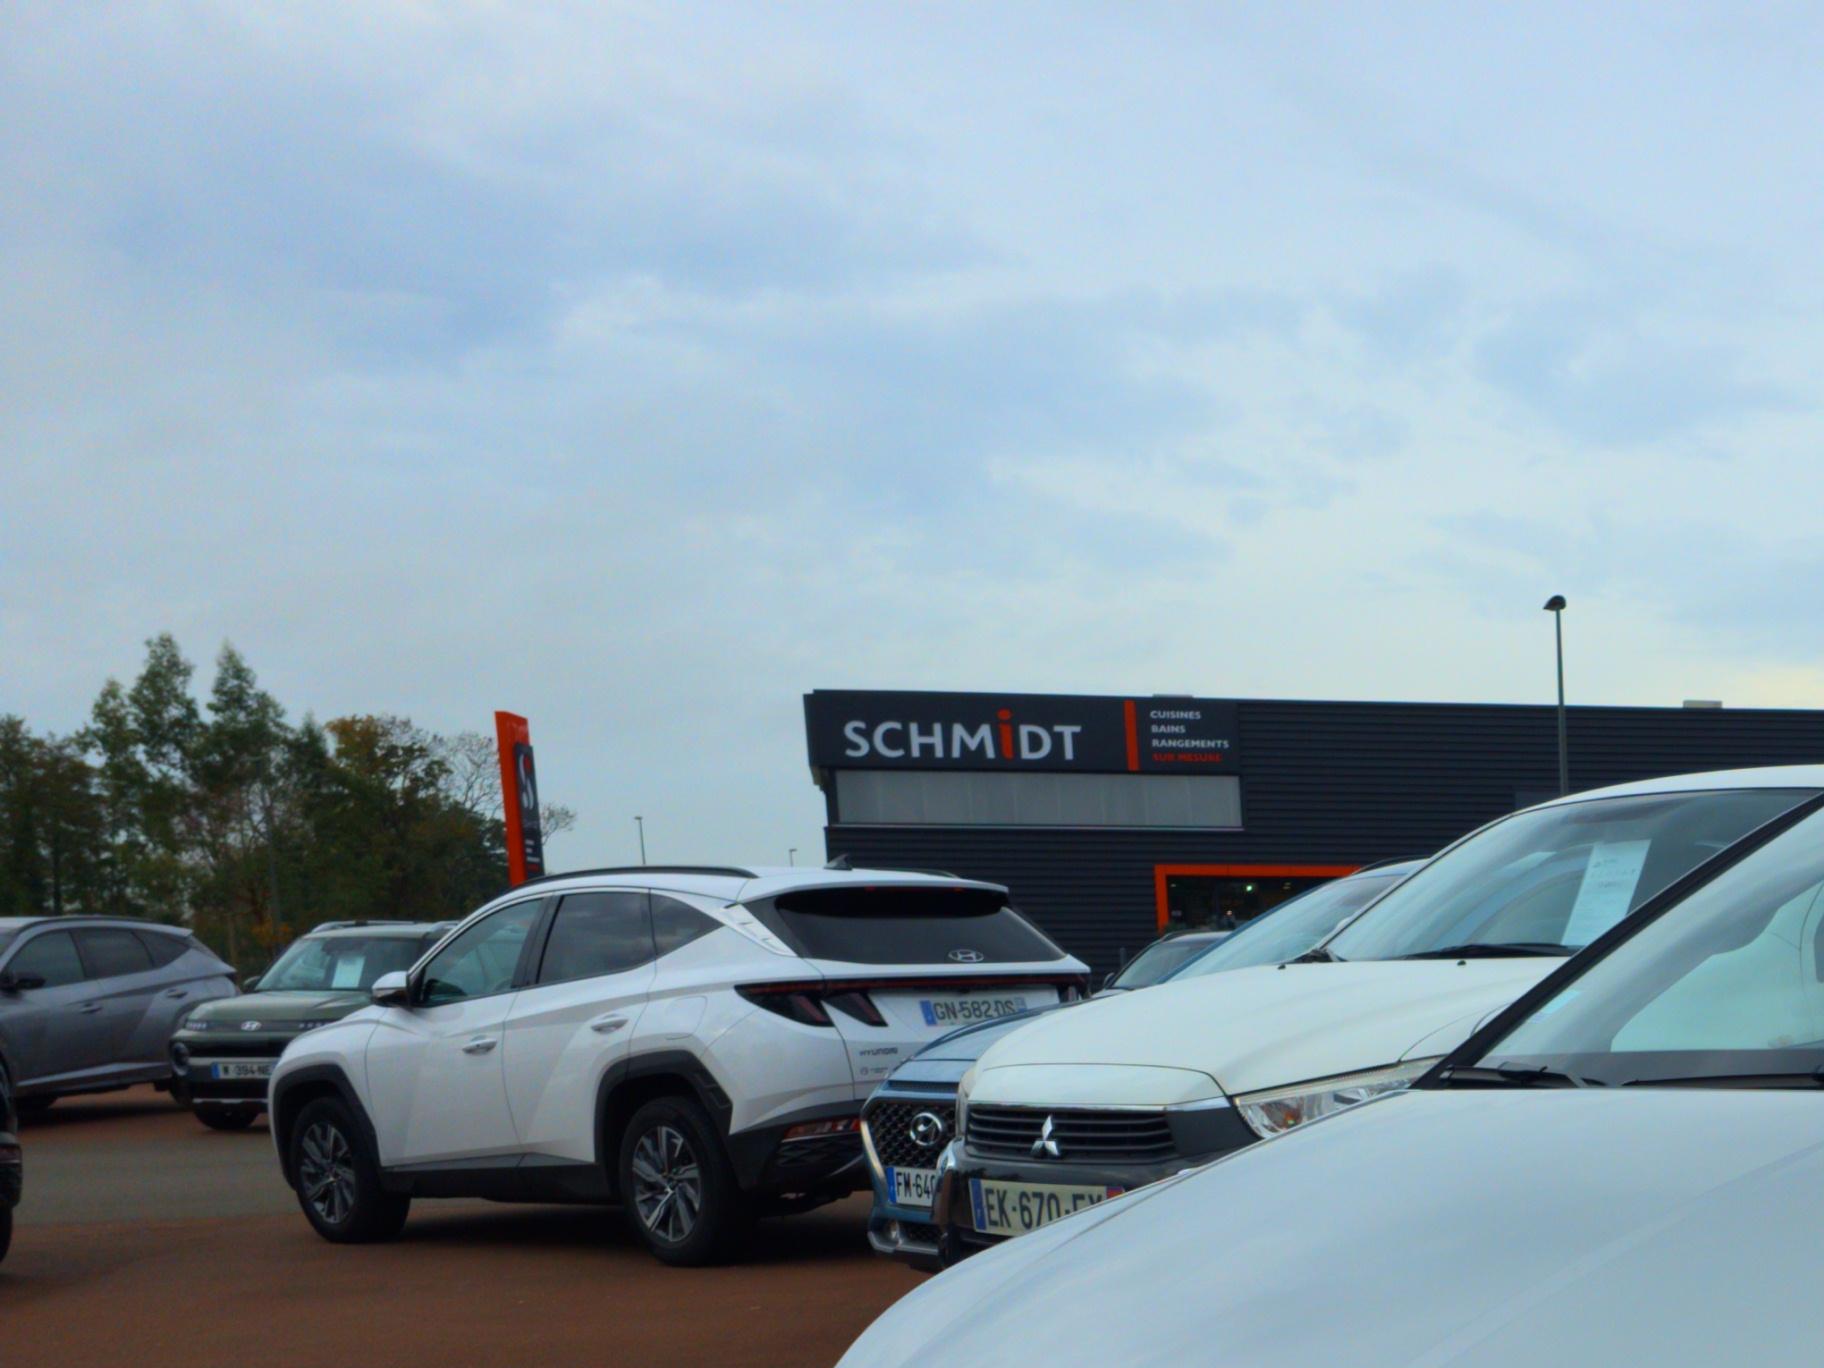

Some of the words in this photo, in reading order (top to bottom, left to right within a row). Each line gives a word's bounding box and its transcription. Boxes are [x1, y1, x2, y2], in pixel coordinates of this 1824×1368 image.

[1150, 710, 1202, 720] CUISINES
[1151, 724, 1186, 734] BAINS
[1151, 739, 1230, 749] RANGEMENTS
